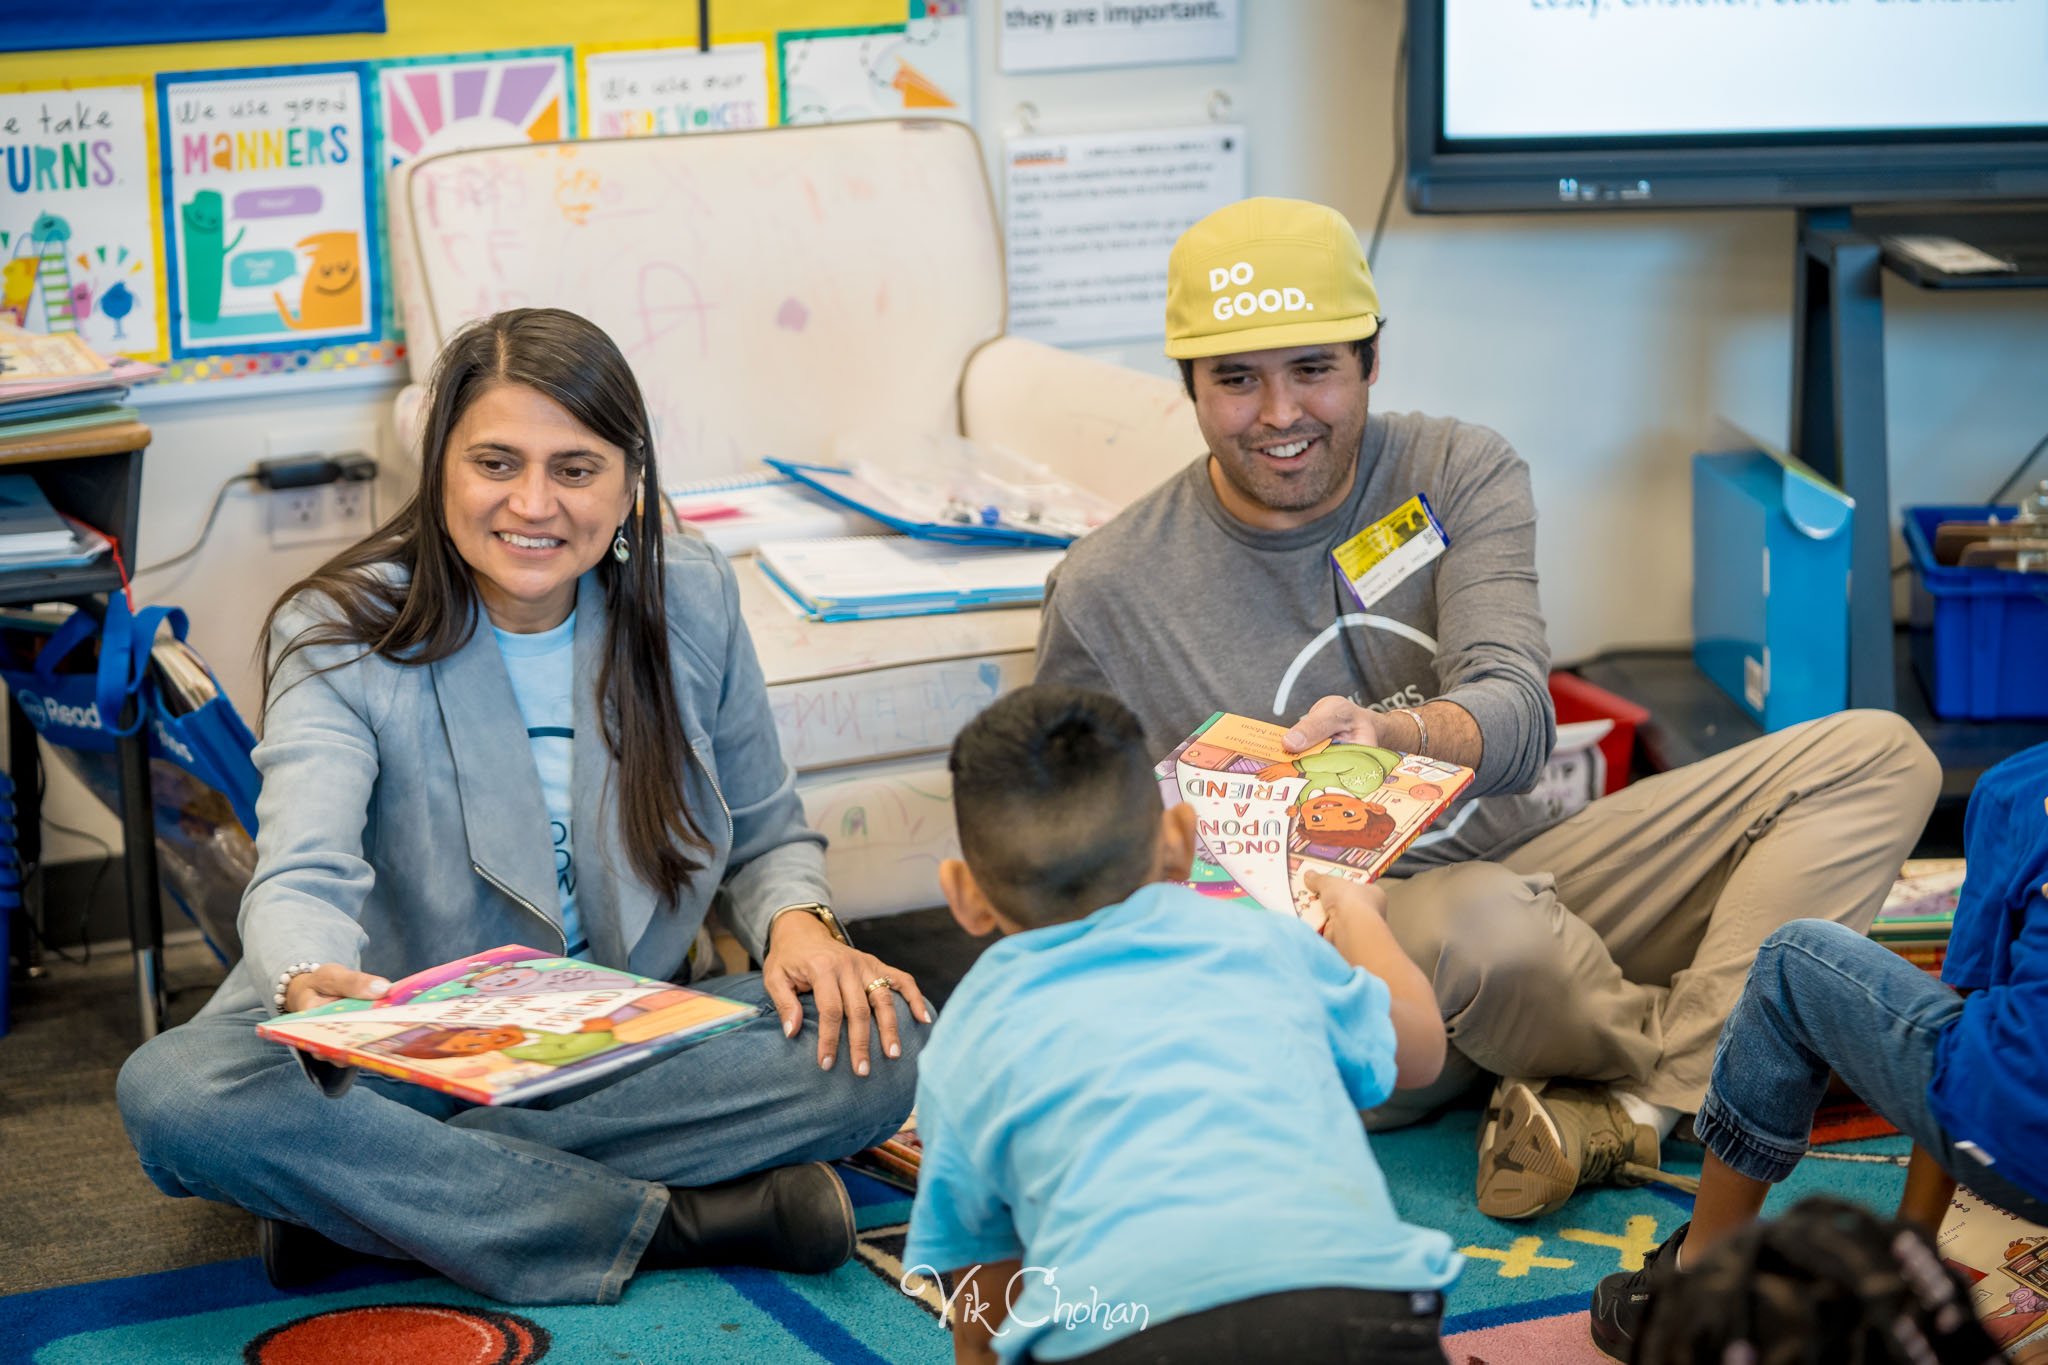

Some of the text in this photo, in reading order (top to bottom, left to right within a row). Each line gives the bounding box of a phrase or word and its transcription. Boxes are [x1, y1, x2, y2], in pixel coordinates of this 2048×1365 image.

[1006, 7, 1055, 33] they
[1064, 7, 1098, 25] are
[602, 73, 746, 101] We use our
[38, 102, 113, 134] take
[176, 88, 347, 124] We use good
[0, 140, 125, 193] URNS.
[1208, 261, 1254, 292] DO
[1212, 287, 1314, 321] GOOD.
[1185, 778, 1290, 801] FRIEND
[1234, 803, 1250, 818] A
[1199, 820, 1281, 836] UPON
[1211, 840, 1280, 855] ONCE
